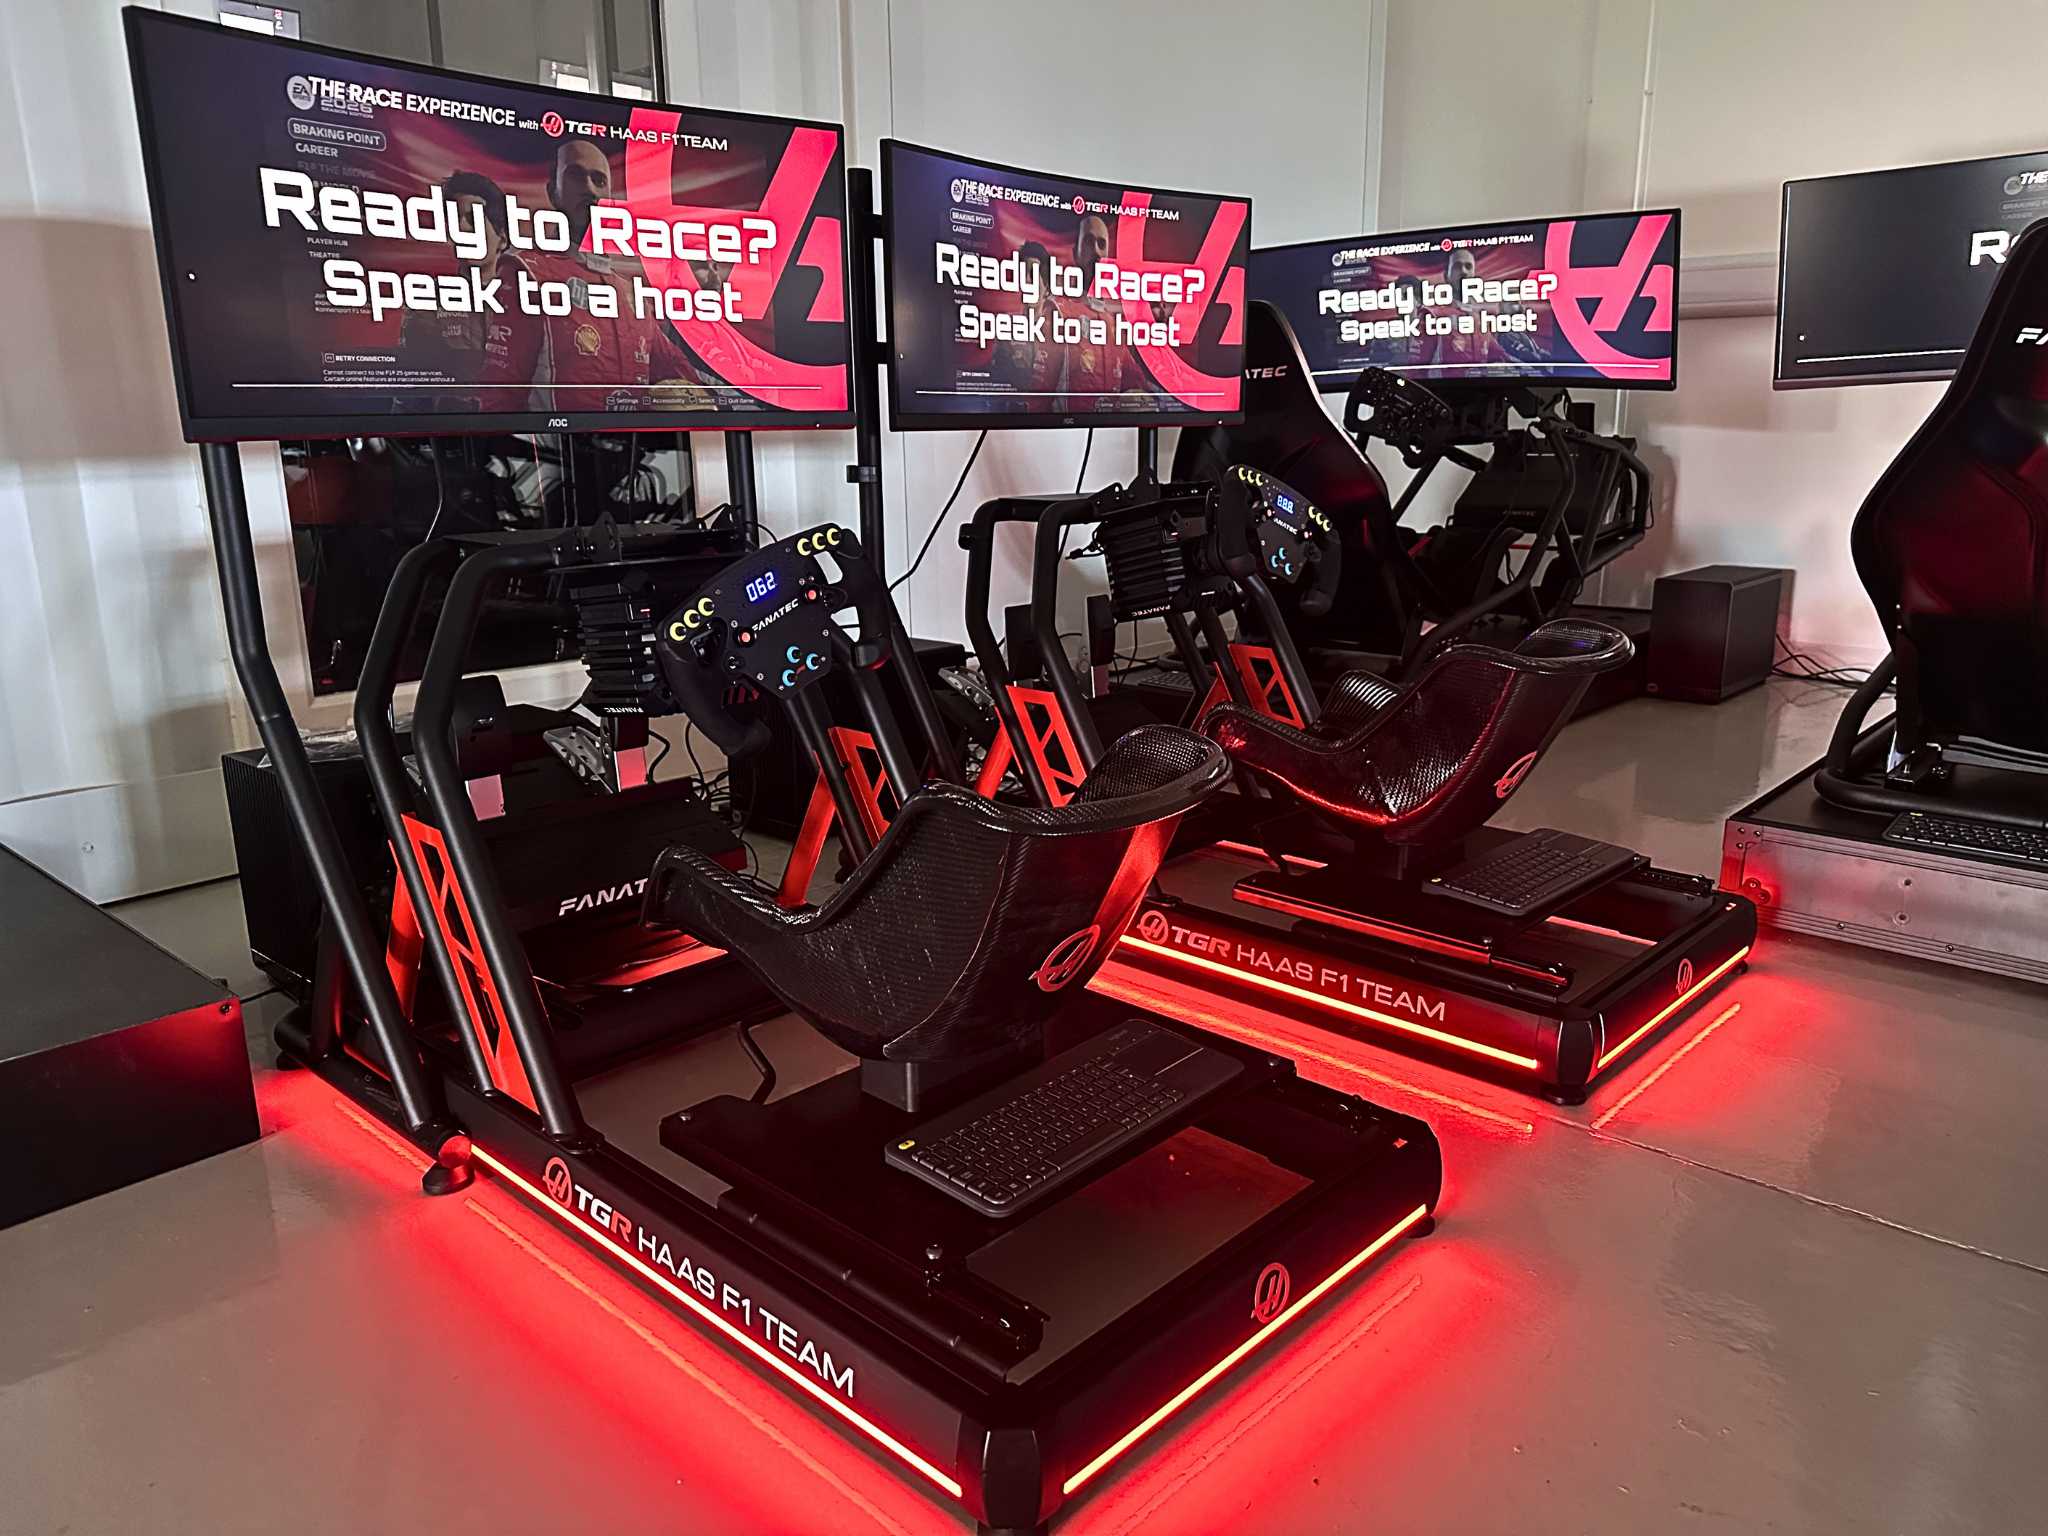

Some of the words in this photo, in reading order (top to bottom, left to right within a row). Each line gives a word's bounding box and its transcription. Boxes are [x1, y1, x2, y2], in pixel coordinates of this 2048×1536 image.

[293, 123, 345, 140] BRAKING
[347, 132, 380, 145] POINT
[308, 76, 345, 100] THE
[348, 83, 402, 110] RACE
[406, 94, 515, 127] EXPERIENCE
[518, 119, 539, 131] with
[565, 120, 606, 137] TGR
[610, 126, 657, 143] HAAS
[662, 133, 680, 145] F1
[681, 134, 728, 151] TEAM
[295, 142, 339, 158] CAREER
[260, 168, 488, 259] Ready
[506, 195, 571, 252] to
[591, 206, 777, 263] Race?
[960, 178, 978, 195] THE
[978, 182, 1004, 199] RACE
[1004, 187, 1060, 208] EXPERIENCE
[1086, 201, 1108, 213] TGR
[1110, 205, 1138, 216] HAAS
[1150, 209, 1180, 221] TEAM
[323, 260, 505, 321] Speak
[517, 272, 572, 316] to
[588, 285, 619, 317] a
[634, 277, 743, 322] host
[936, 242, 1040, 304] Ready
[1050, 257, 1084, 298] to
[1095, 263, 1205, 303] Race?
[1319, 281, 1415, 315] Ready
[1421, 280, 1454, 307] to
[1462, 273, 1558, 304] Race?
[960, 304, 1046, 348] Speak
[1053, 311, 1081, 343] to
[1089, 320, 1107, 344] a
[1116, 314, 1180, 347] host
[1340, 315, 1421, 346] Speak
[1426, 313, 1452, 336] to
[1458, 316, 1475, 334] a
[1480, 309, 1538, 333] host
[548, 418, 568, 427] AOC
[745, 571, 777, 602] 062
[752, 598, 799, 632] FANATEC
[558, 878, 649, 917] FANAT
[1171, 925, 1231, 958] TGR
[1236, 943, 1313, 983] HAAS
[1320, 968, 1348, 993] F1
[1356, 978, 1446, 1022] TEAM
[574, 1184, 633, 1243] TGR
[637, 1226, 716, 1300] HAAS
[722, 1283, 752, 1326] F1
[758, 1307, 855, 1398] TEAM
